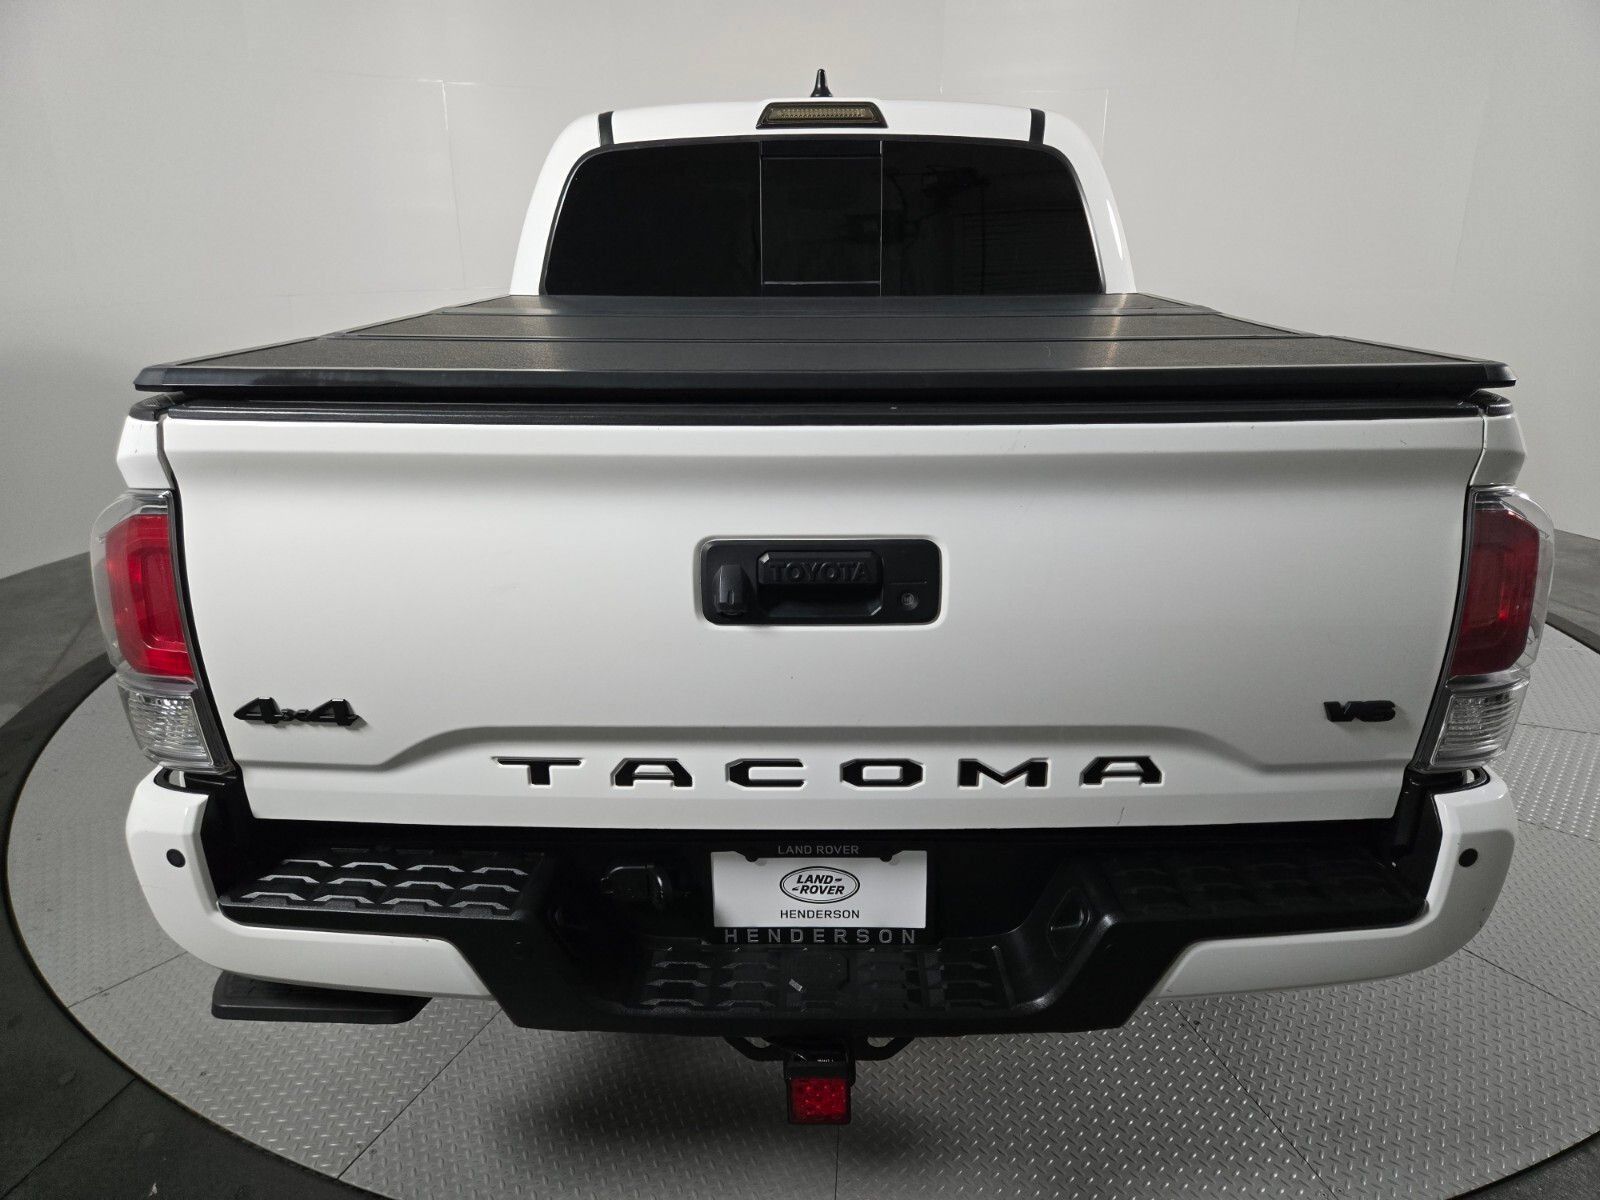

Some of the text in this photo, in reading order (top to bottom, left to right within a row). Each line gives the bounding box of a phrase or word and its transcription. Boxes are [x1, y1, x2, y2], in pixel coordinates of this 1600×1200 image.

[769, 561, 866, 582] TOYOTA
[1323, 700, 1396, 722] V6
[493, 756, 1162, 788] TACOMA
[777, 845, 860, 856] LAND ROVER
[796, 874, 834, 885] LAND
[800, 885, 846, 896] ROVER
[780, 909, 860, 919] HENDERSON
[724, 929, 917, 944] HENDERSON
